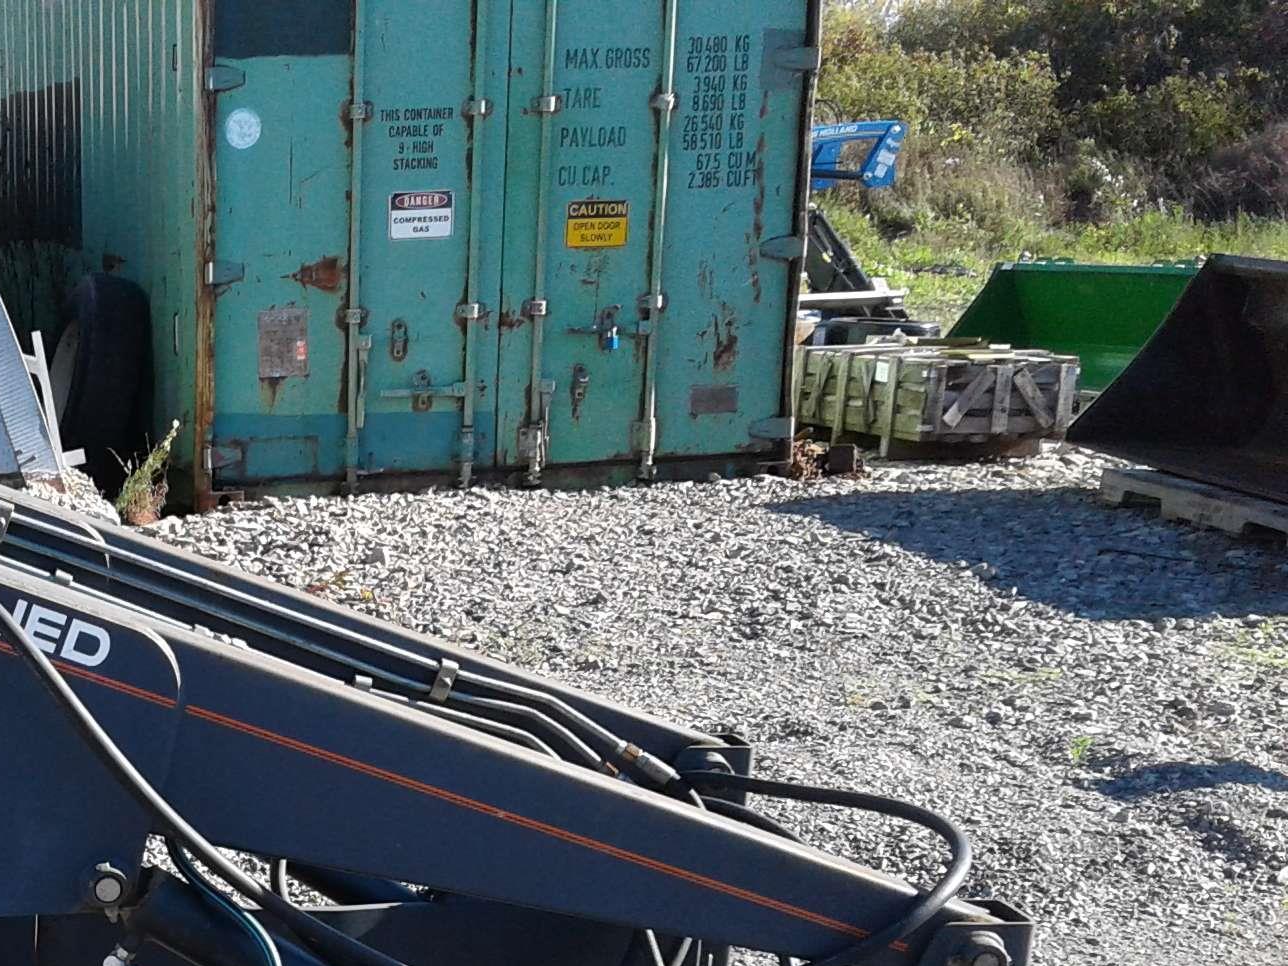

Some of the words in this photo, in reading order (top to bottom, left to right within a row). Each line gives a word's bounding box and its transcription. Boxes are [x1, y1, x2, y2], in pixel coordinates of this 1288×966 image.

[735, 34, 750, 52] KG
[606, 47, 650, 69] GROSS
[734, 53, 749, 71] LB
[732, 74, 748, 91] KG
[563, 87, 602, 109] TARE
[731, 92, 746, 111] LB
[380, 109, 400, 121] THIS
[404, 107, 453, 121] CONTAINER
[730, 112, 744, 130] KG
[388, 124, 428, 138] CAPABLE
[433, 123, 444, 136] OF
[560, 126, 627, 148] PAYLOAD
[729, 131, 743, 149] LB
[393, 157, 439, 171] STACKING
[403, 195, 440, 208] DANGER
[569, 203, 627, 217] CAUTION
[393, 215, 450, 224] COMPRESSED
[573, 221, 595, 231] OPEN
[597, 221, 621, 230] DOOR
[412, 225, 430, 233] GAS
[580, 233, 613, 242] SLOWLY
